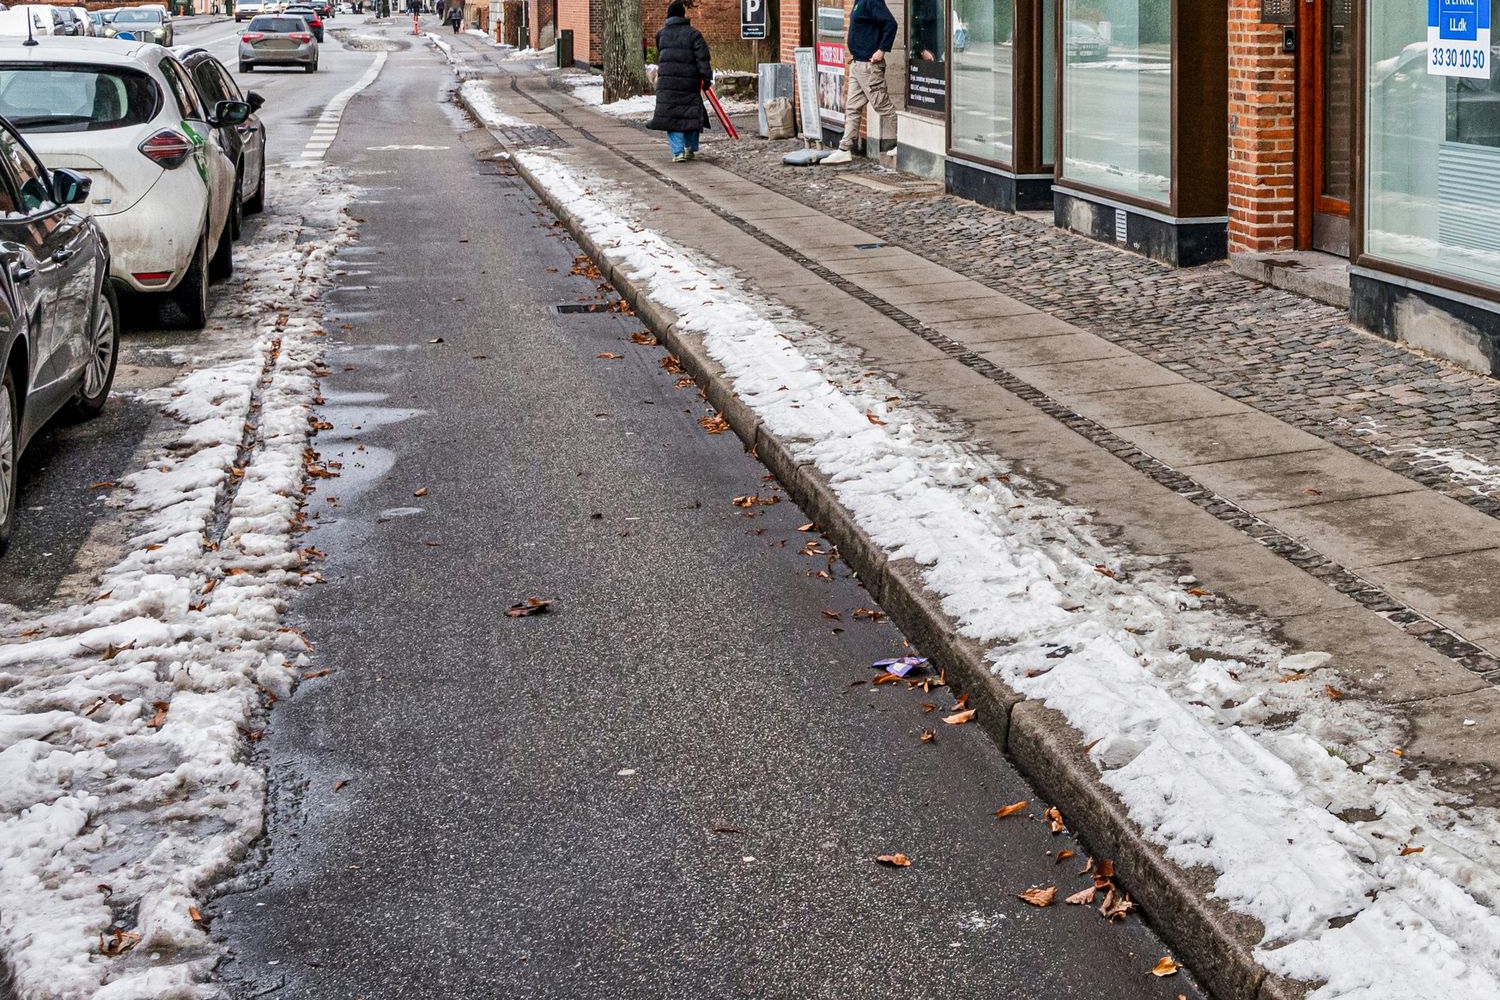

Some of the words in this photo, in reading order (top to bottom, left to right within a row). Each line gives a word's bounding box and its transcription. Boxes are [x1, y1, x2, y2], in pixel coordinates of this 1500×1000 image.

[1449, 17, 1467, 31] LL.dk
[1432, 47, 1444, 65] 33
[1445, 48, 1458, 67] 30
[1460, 49, 1471, 68] 10
[1472, 49, 1485, 69] 50
